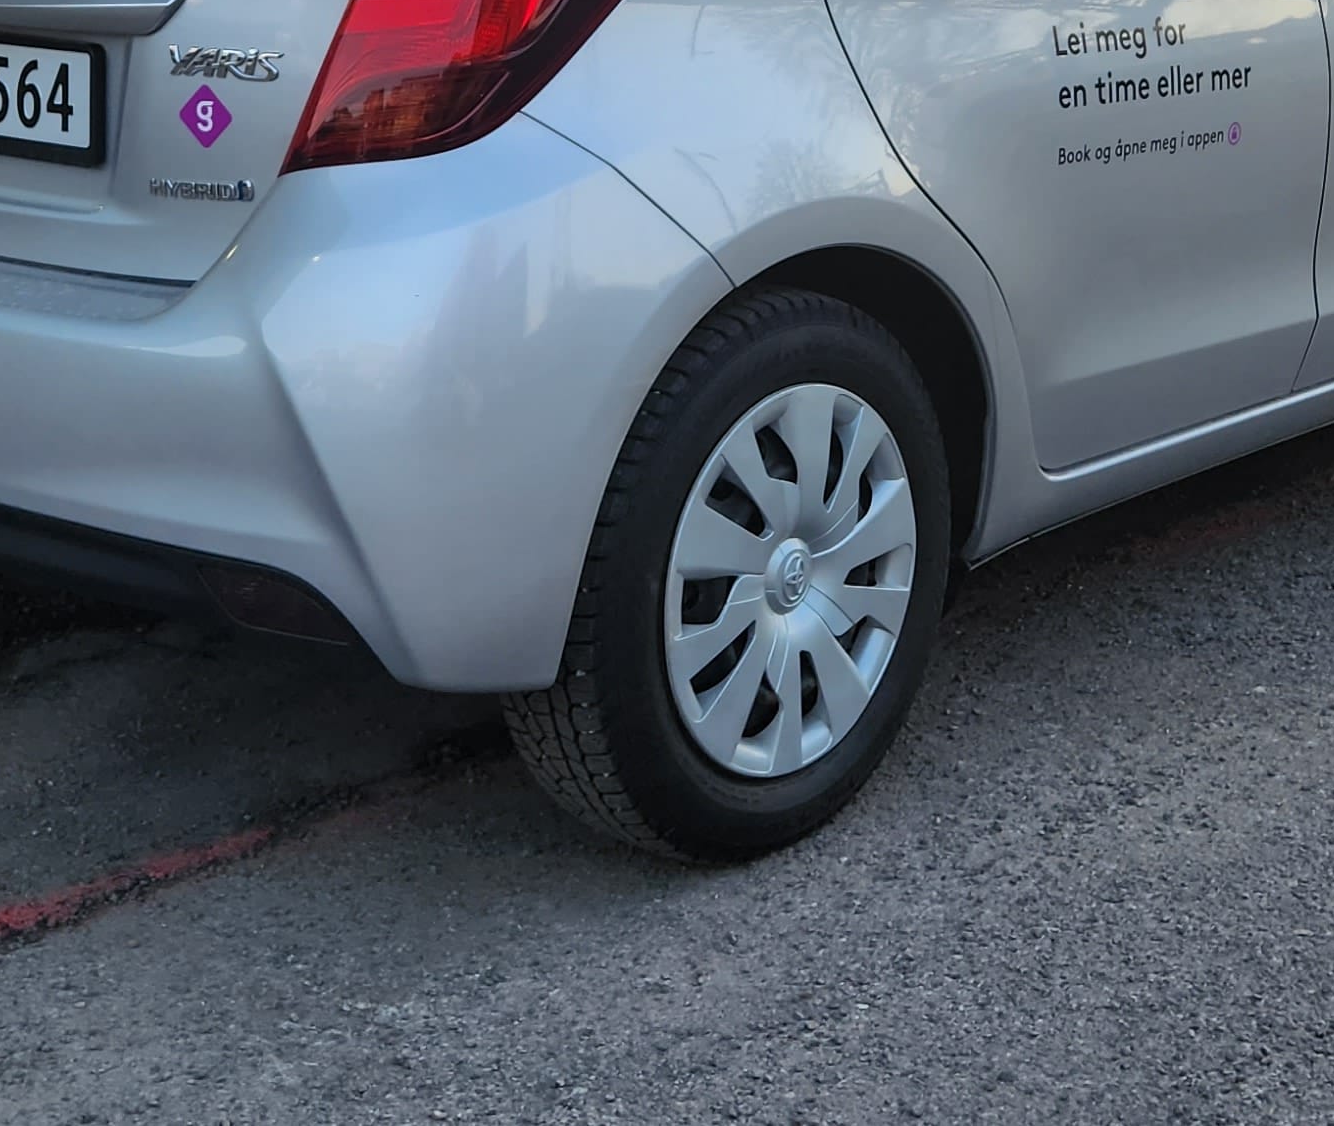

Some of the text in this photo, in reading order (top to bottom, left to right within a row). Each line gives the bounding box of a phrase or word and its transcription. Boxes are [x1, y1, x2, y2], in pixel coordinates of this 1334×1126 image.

[1052, 16, 1186, 59] Lei meg for
[1058, 65, 1251, 109] en time eller mer
[196, 100, 214, 132] g
[1058, 144, 1091, 165] Book
[1095, 146, 1111, 164] og
[1114, 138, 1147, 161] åpne
[1150, 136, 1177, 154] meg
[1187, 130, 1225, 151] appen
[149, 178, 238, 201] HYBRID
